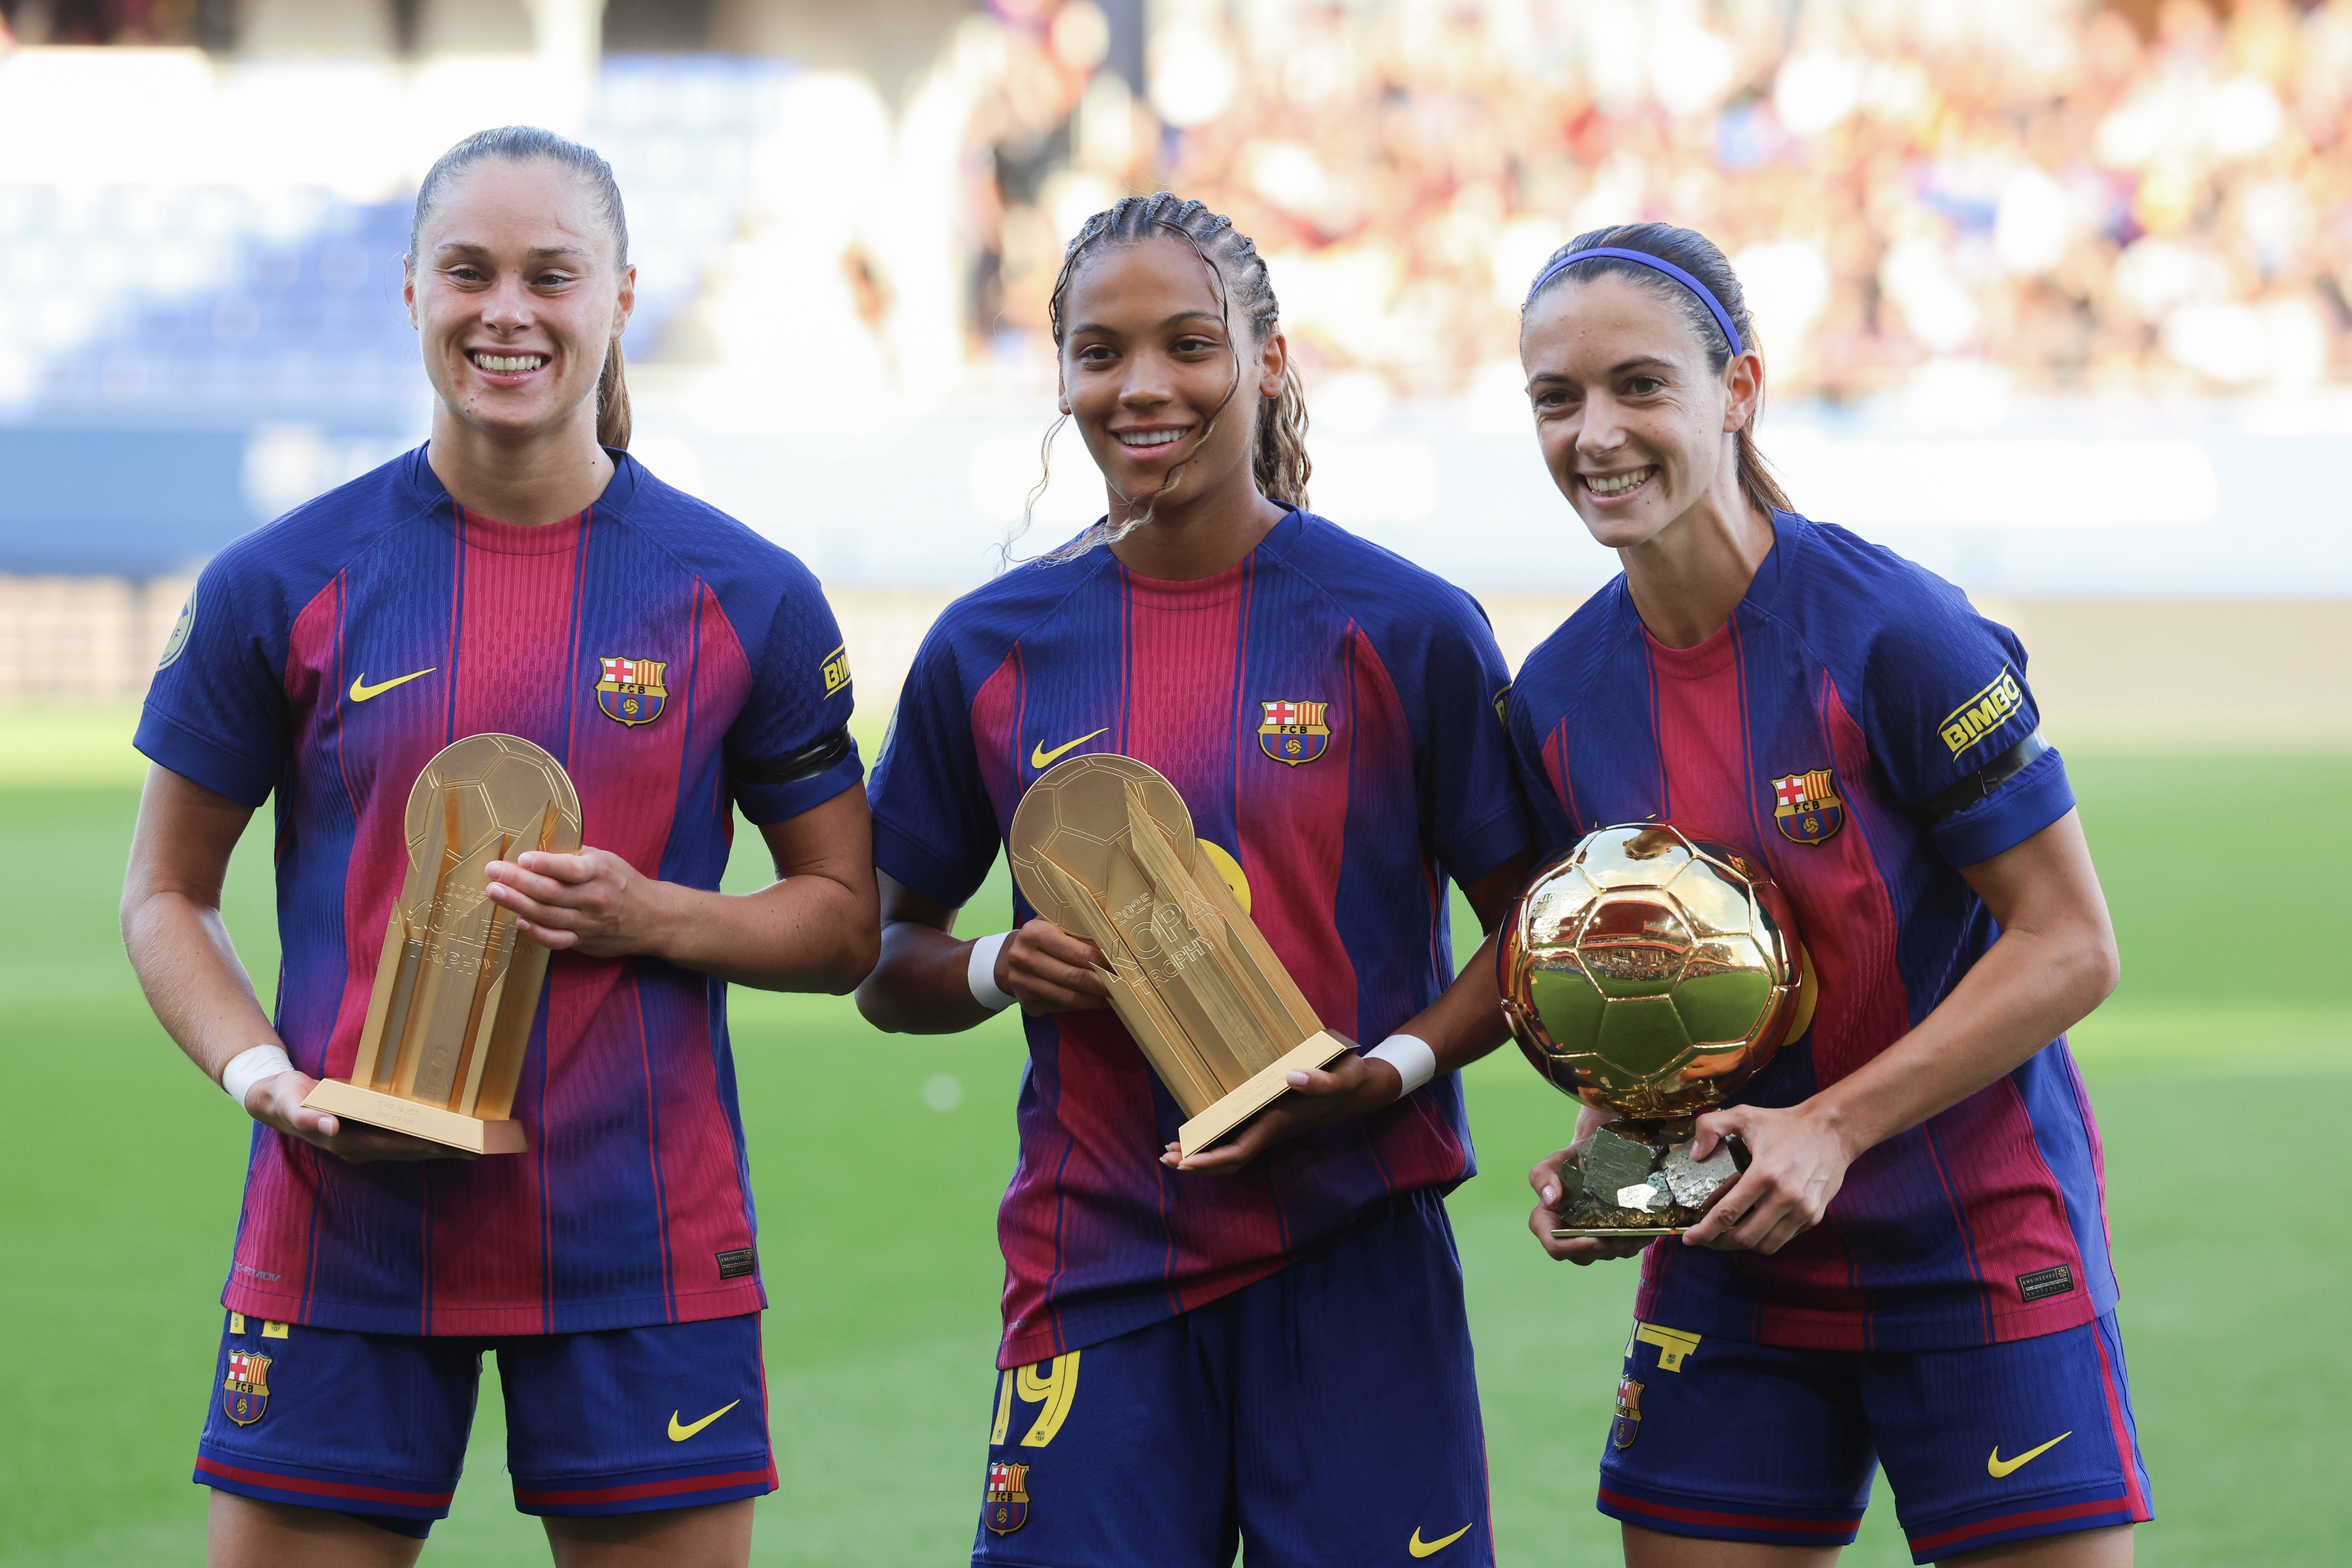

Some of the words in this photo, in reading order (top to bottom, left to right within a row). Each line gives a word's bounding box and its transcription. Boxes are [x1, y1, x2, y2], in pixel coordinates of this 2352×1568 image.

[618, 683, 645, 694] FCB
[1941, 674, 2019, 752] BIMBO
[1280, 726, 1307, 734] FCB
[1794, 801, 1820, 813] FCB
[444, 882, 486, 905] 2025
[1563, 892, 1584, 901] D'OR
[1112, 892, 1152, 927] 2025
[1541, 917, 1561, 926] 2025
[1089, 890, 1221, 983] KOPA
[1132, 931, 1216, 995] TROPHY
[2023, 1273, 2056, 1285] ENGINEERED
[235, 1382, 253, 1394] FCB
[990, 1349, 1081, 1447] 19
[1619, 1405, 1630, 1418] FCB
[995, 1492, 1013, 1502] FCB
